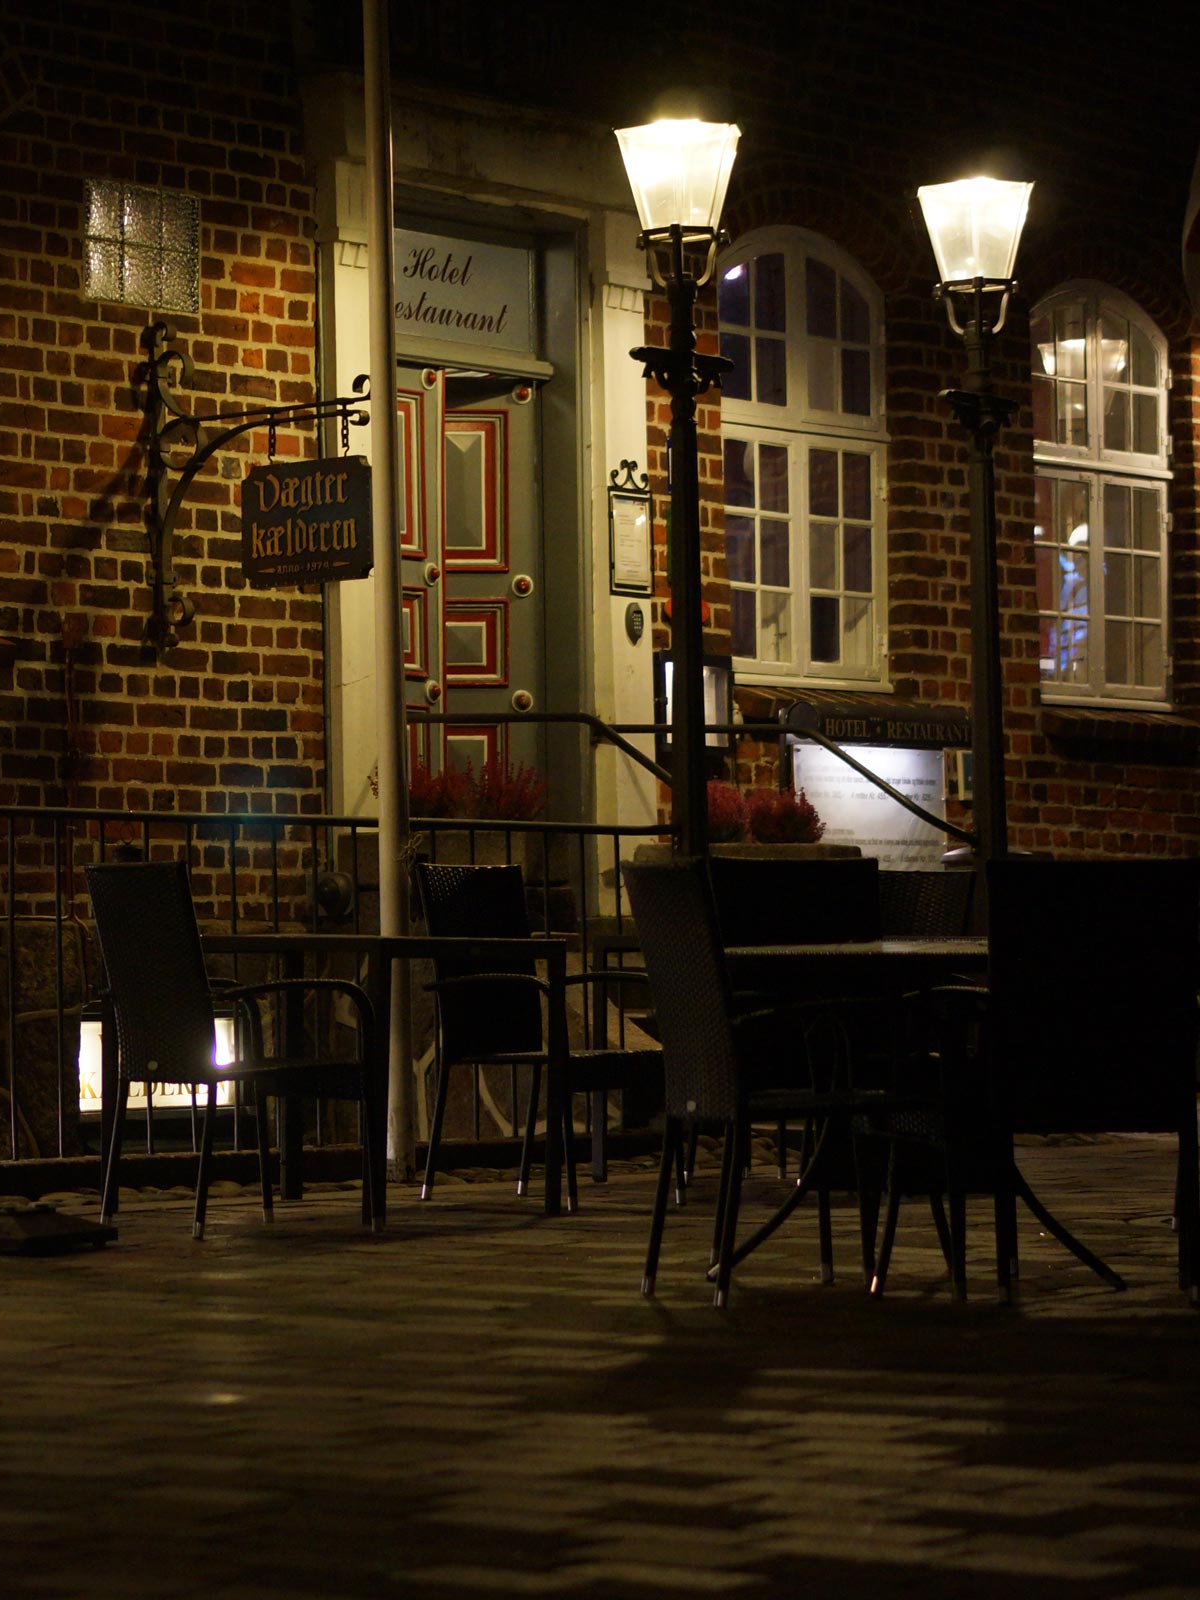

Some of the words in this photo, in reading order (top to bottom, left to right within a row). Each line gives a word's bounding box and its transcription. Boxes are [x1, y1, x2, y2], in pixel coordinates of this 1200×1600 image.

[403, 247, 473, 287] Hotel
[395, 291, 509, 334] estaurant
[254, 471, 348, 515] Vægter
[251, 518, 358, 559] kælderen
[825, 718, 871, 738] HOTEL
[887, 720, 969, 742] RESTAURANT
